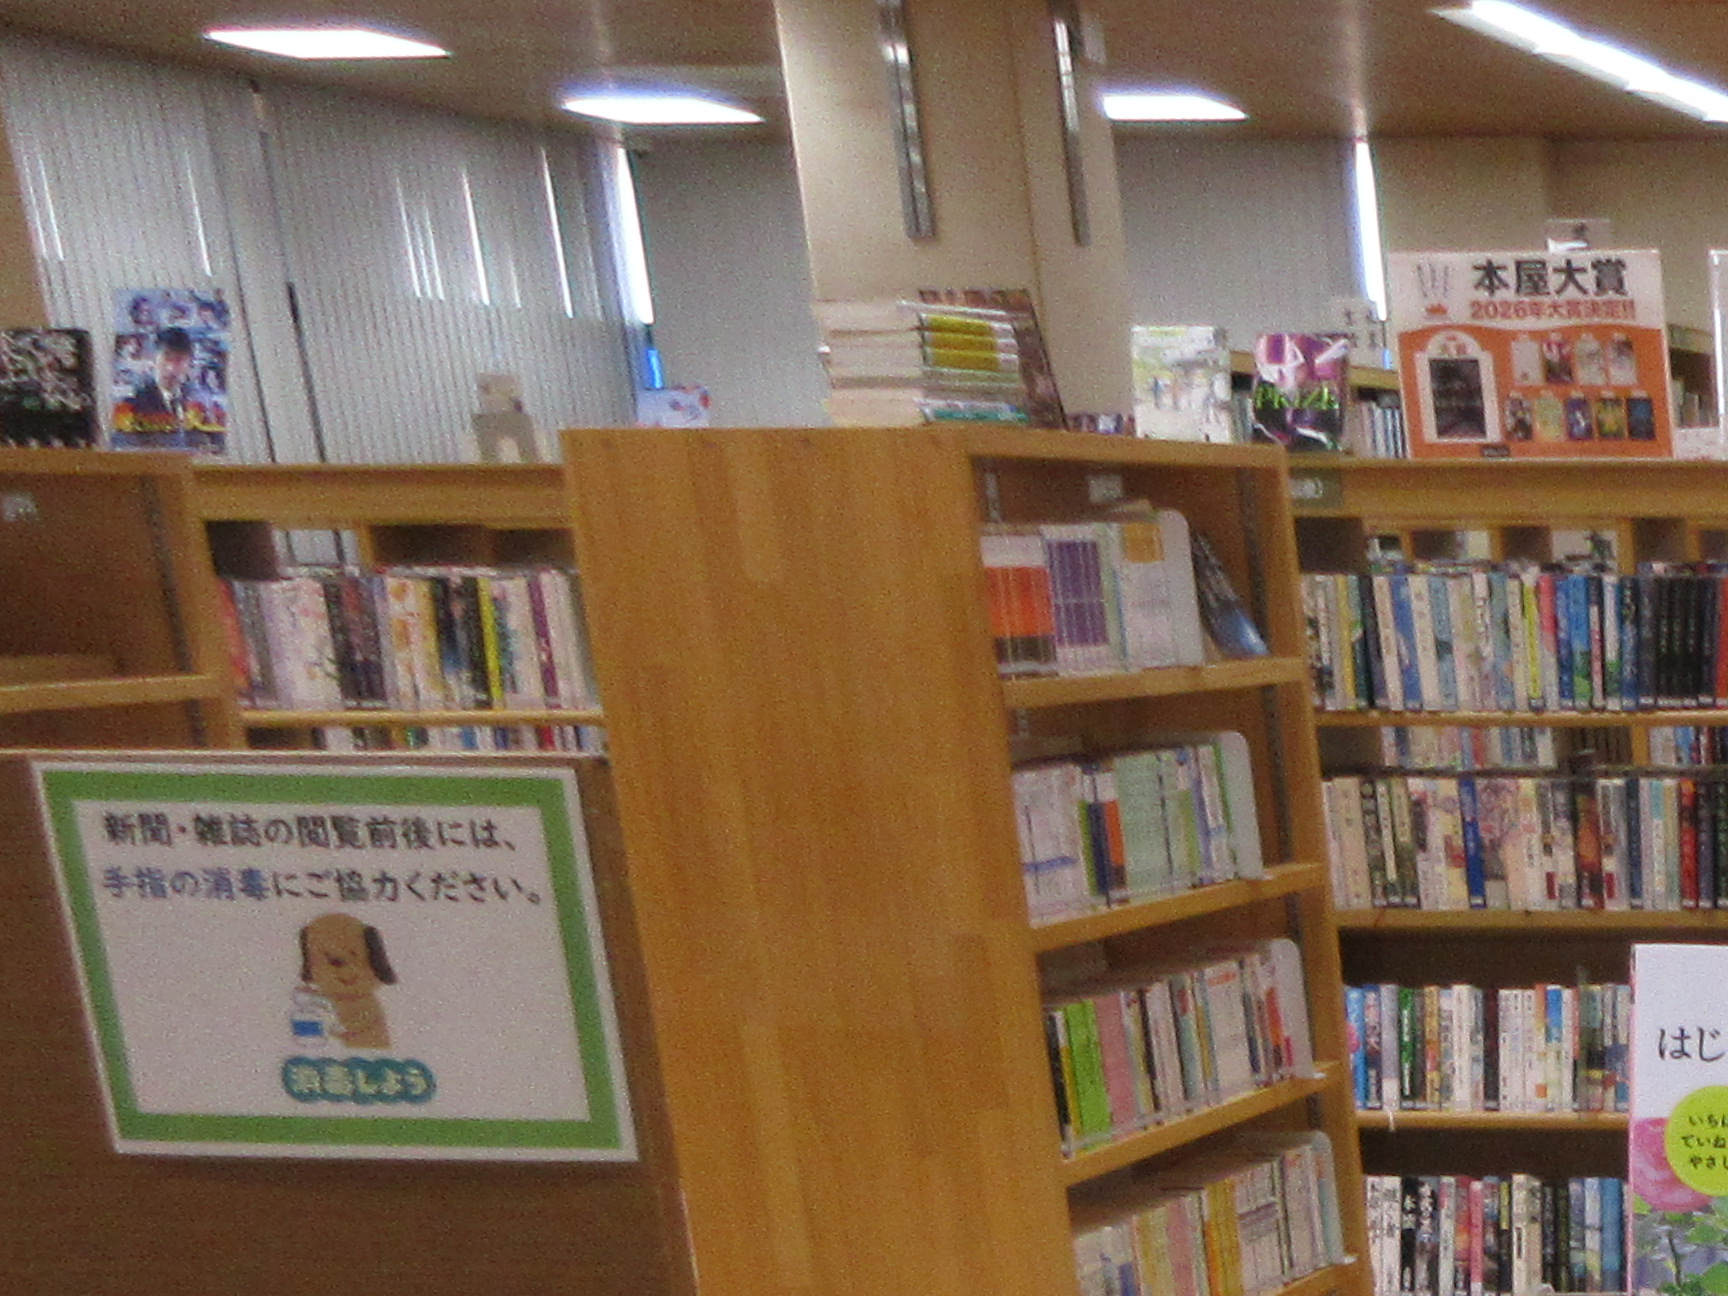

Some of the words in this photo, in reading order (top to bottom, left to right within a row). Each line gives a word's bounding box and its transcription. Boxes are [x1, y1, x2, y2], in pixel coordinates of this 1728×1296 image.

[1472, 258, 1628, 296] 本屋大賞
[104, 812, 517, 852] 新聞・雑誌の閲覧前後には、
[103, 866, 542, 905] 手指の消毒にご協力ください。
